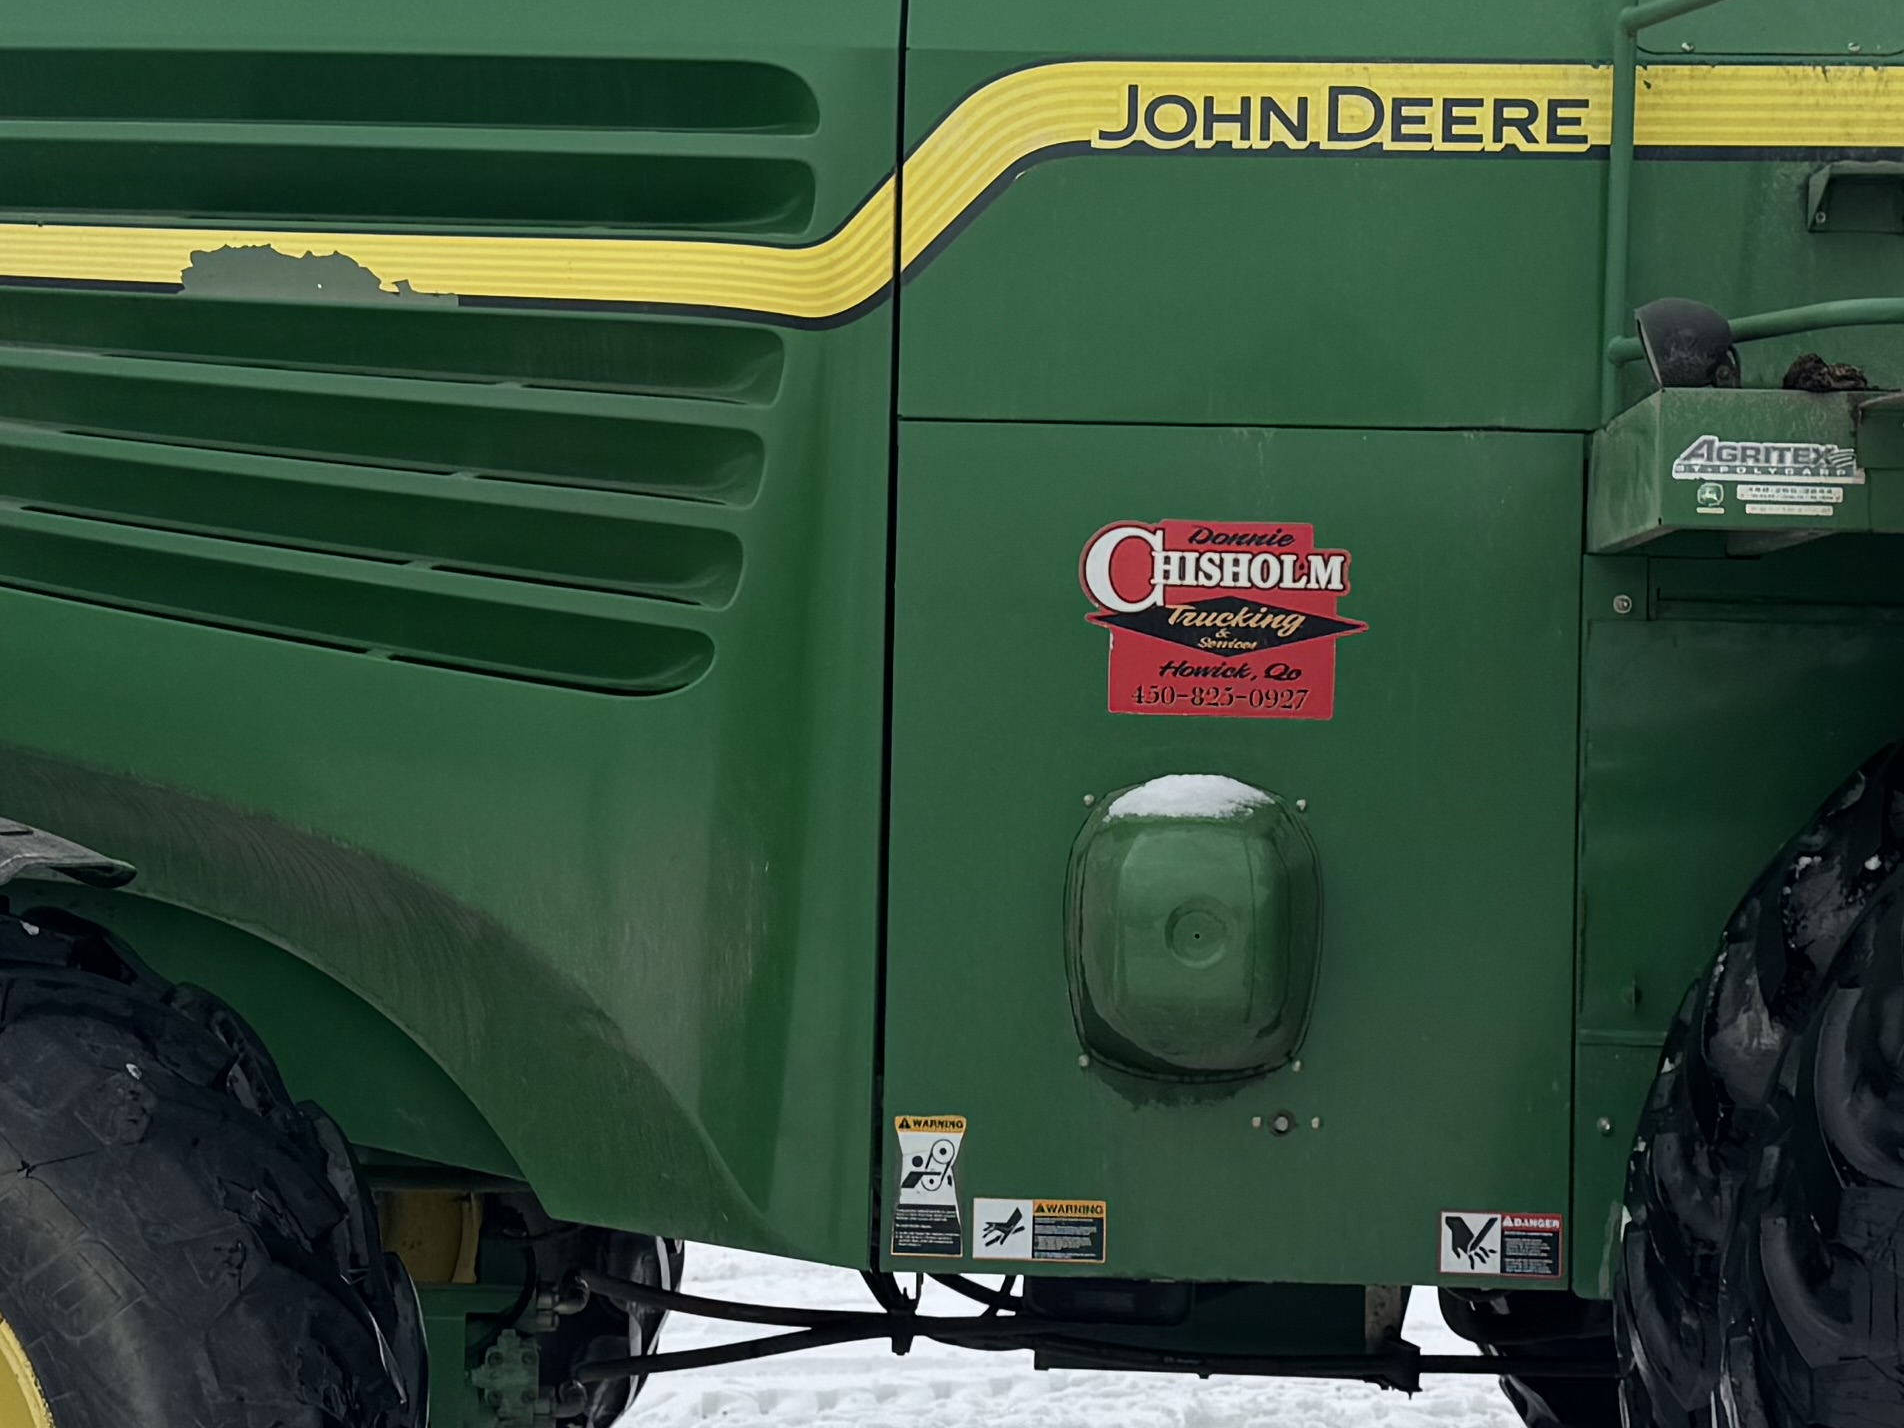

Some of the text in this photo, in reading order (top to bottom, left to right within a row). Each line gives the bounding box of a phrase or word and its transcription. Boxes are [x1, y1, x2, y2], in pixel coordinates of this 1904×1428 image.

[1098, 84, 1591, 145] JOHN DEERE
[1682, 439, 1837, 464] AGRITEX
[1188, 526, 1296, 547] Donnie
[1086, 526, 1345, 613] CHISHOLM
[1164, 604, 1306, 637] Trucking
[1215, 629, 1231, 638] &
[1131, 684, 1309, 710] 450-825-0927
[913, 1119, 964, 1129] WARNING
[1046, 1204, 1104, 1215] WARNING
[1514, 1219, 1559, 1228] DANGER
